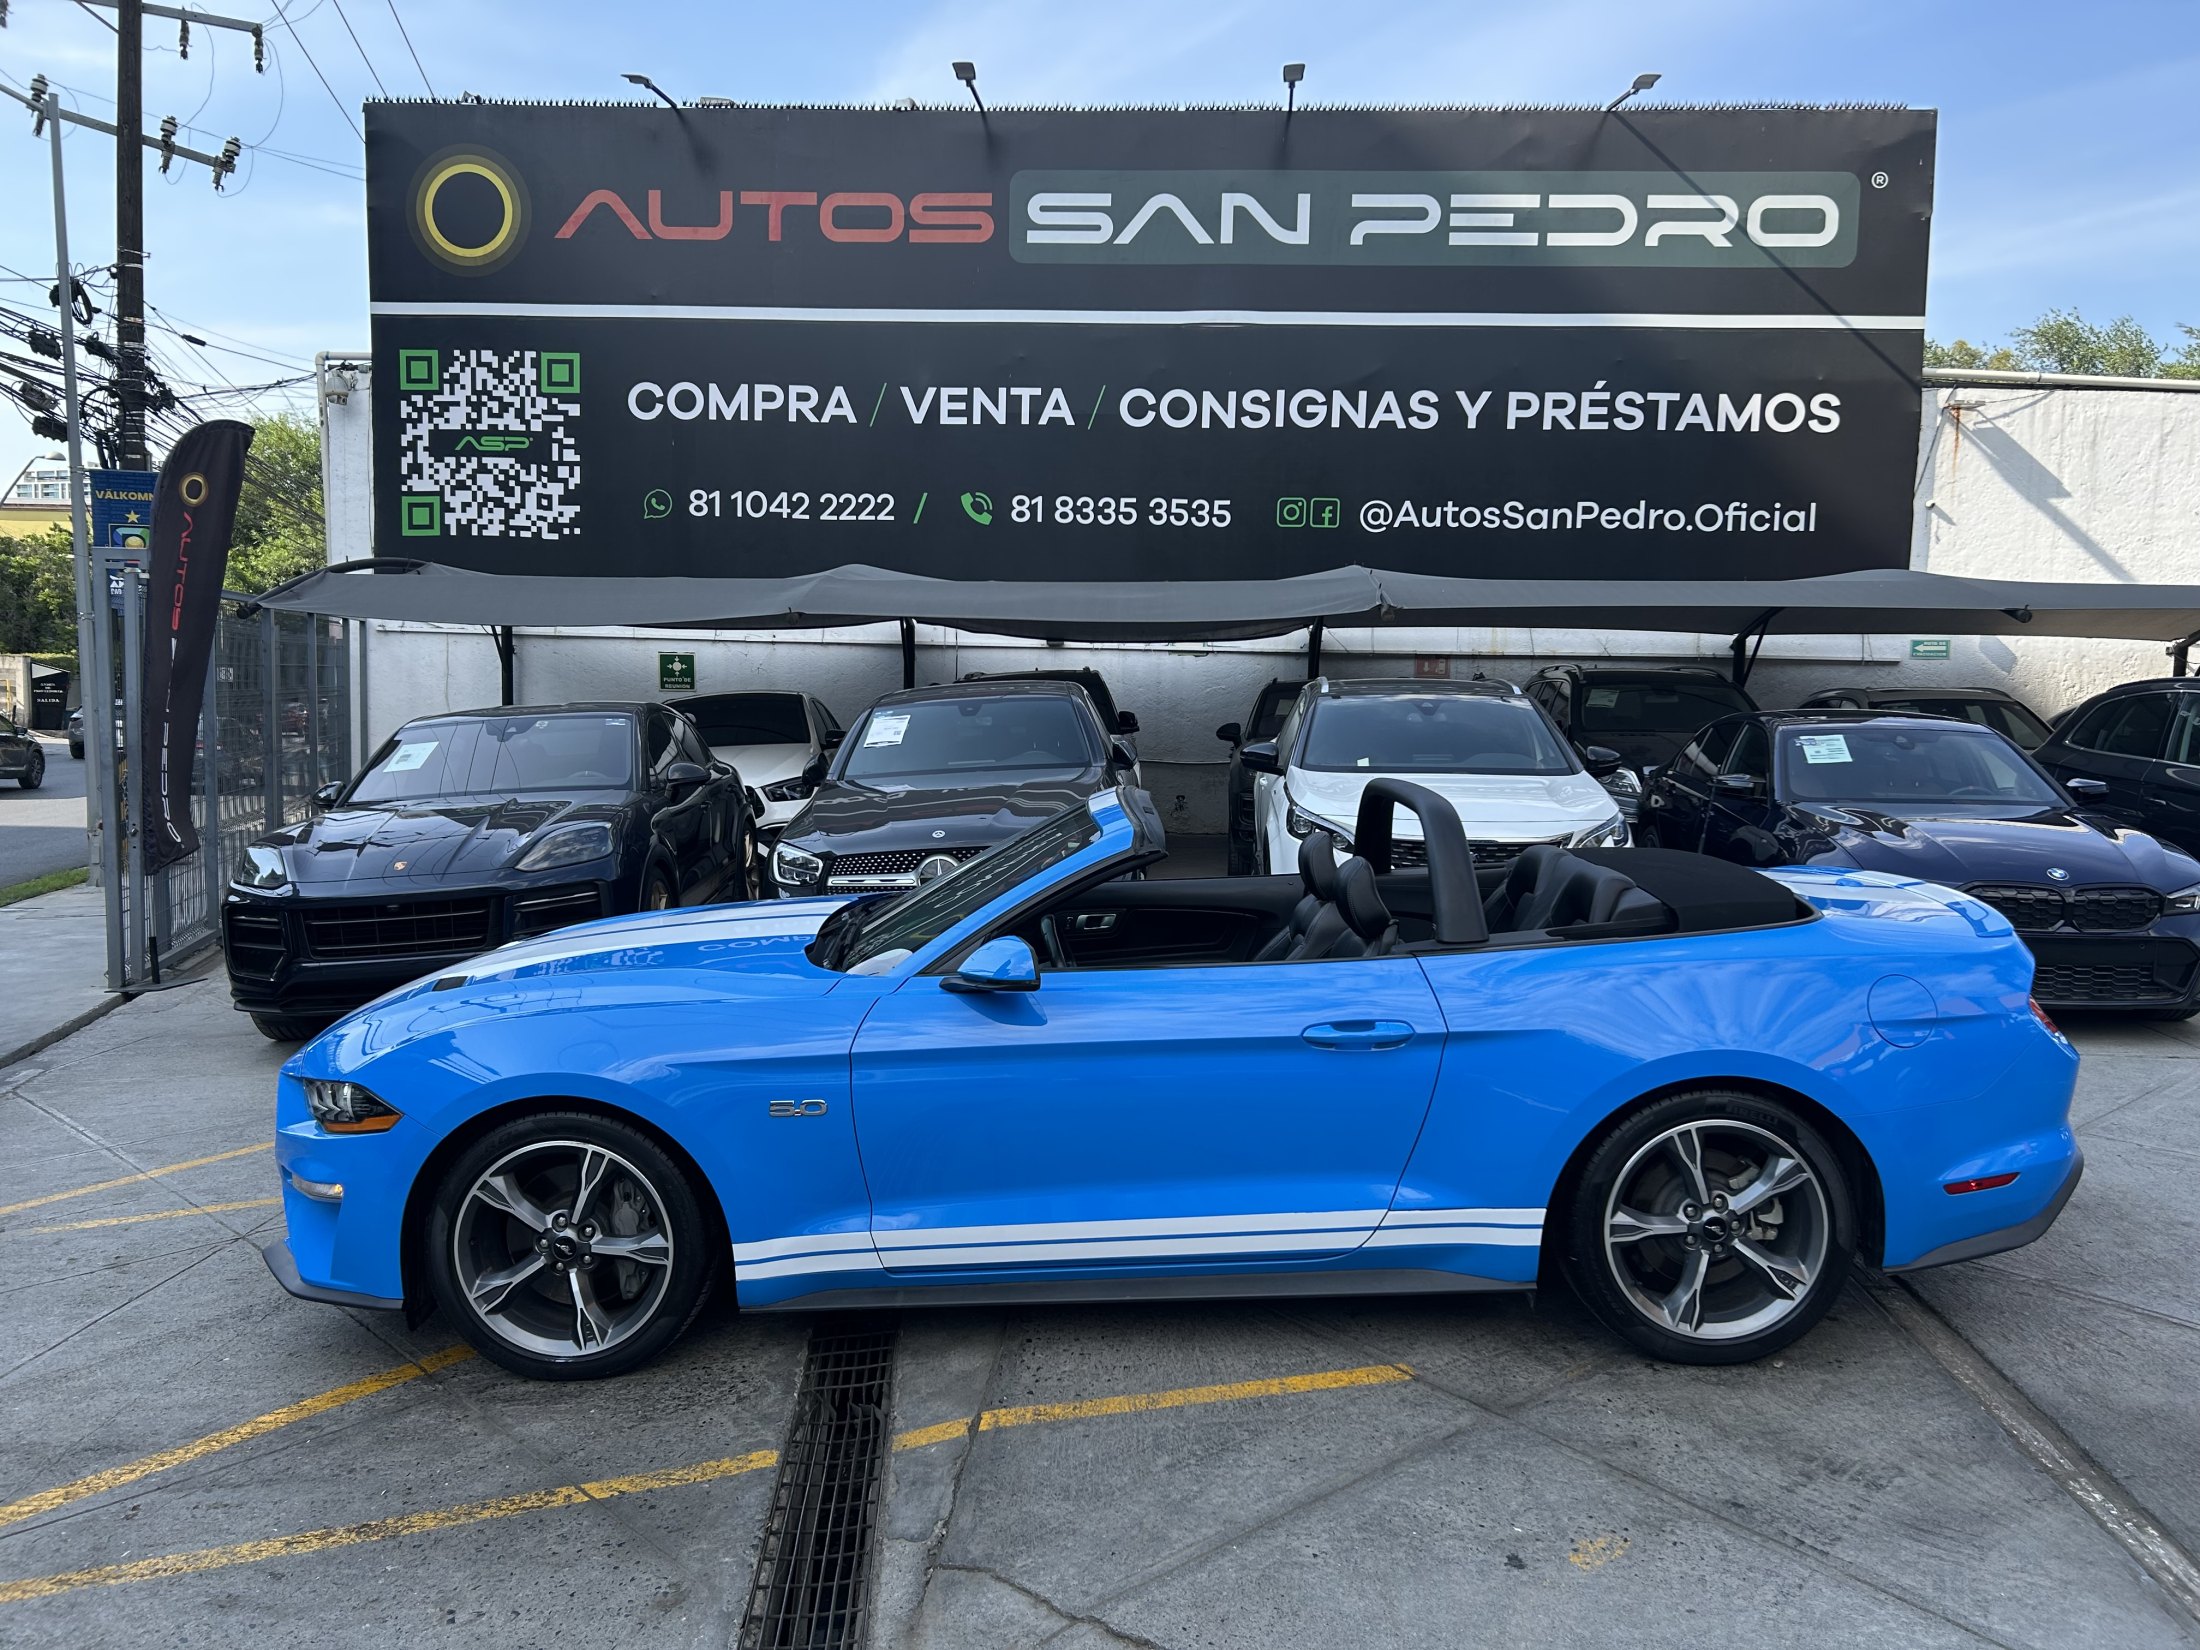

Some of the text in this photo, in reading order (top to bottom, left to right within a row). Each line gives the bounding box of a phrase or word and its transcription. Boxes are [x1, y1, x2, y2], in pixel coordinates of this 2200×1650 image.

[554, 189, 995, 243] AUTOS
[1026, 191, 1311, 246] SAN
[1349, 192, 1840, 249] PEDRO
[627, 381, 858, 424] COMPRA
[899, 386, 1076, 426] VENTA
[1119, 387, 1439, 430] CONSIGNAS
[1455, 390, 1493, 429] Y
[1506, 380, 1841, 434] PRÉSTAMOS
[455, 435, 530, 451] ASP
[688, 489, 720, 517] 81
[730, 490, 810, 520] 1042
[819, 493, 895, 521] 2222
[1010, 494, 1043, 523] 81
[1054, 495, 1138, 526] 8335
[1148, 497, 1232, 528] 3535
[1359, 499, 1817, 534] @AutosSanPedro.Oficial
[171, 511, 194, 631] AUTOS
[769, 1099, 828, 1117] 5.0
